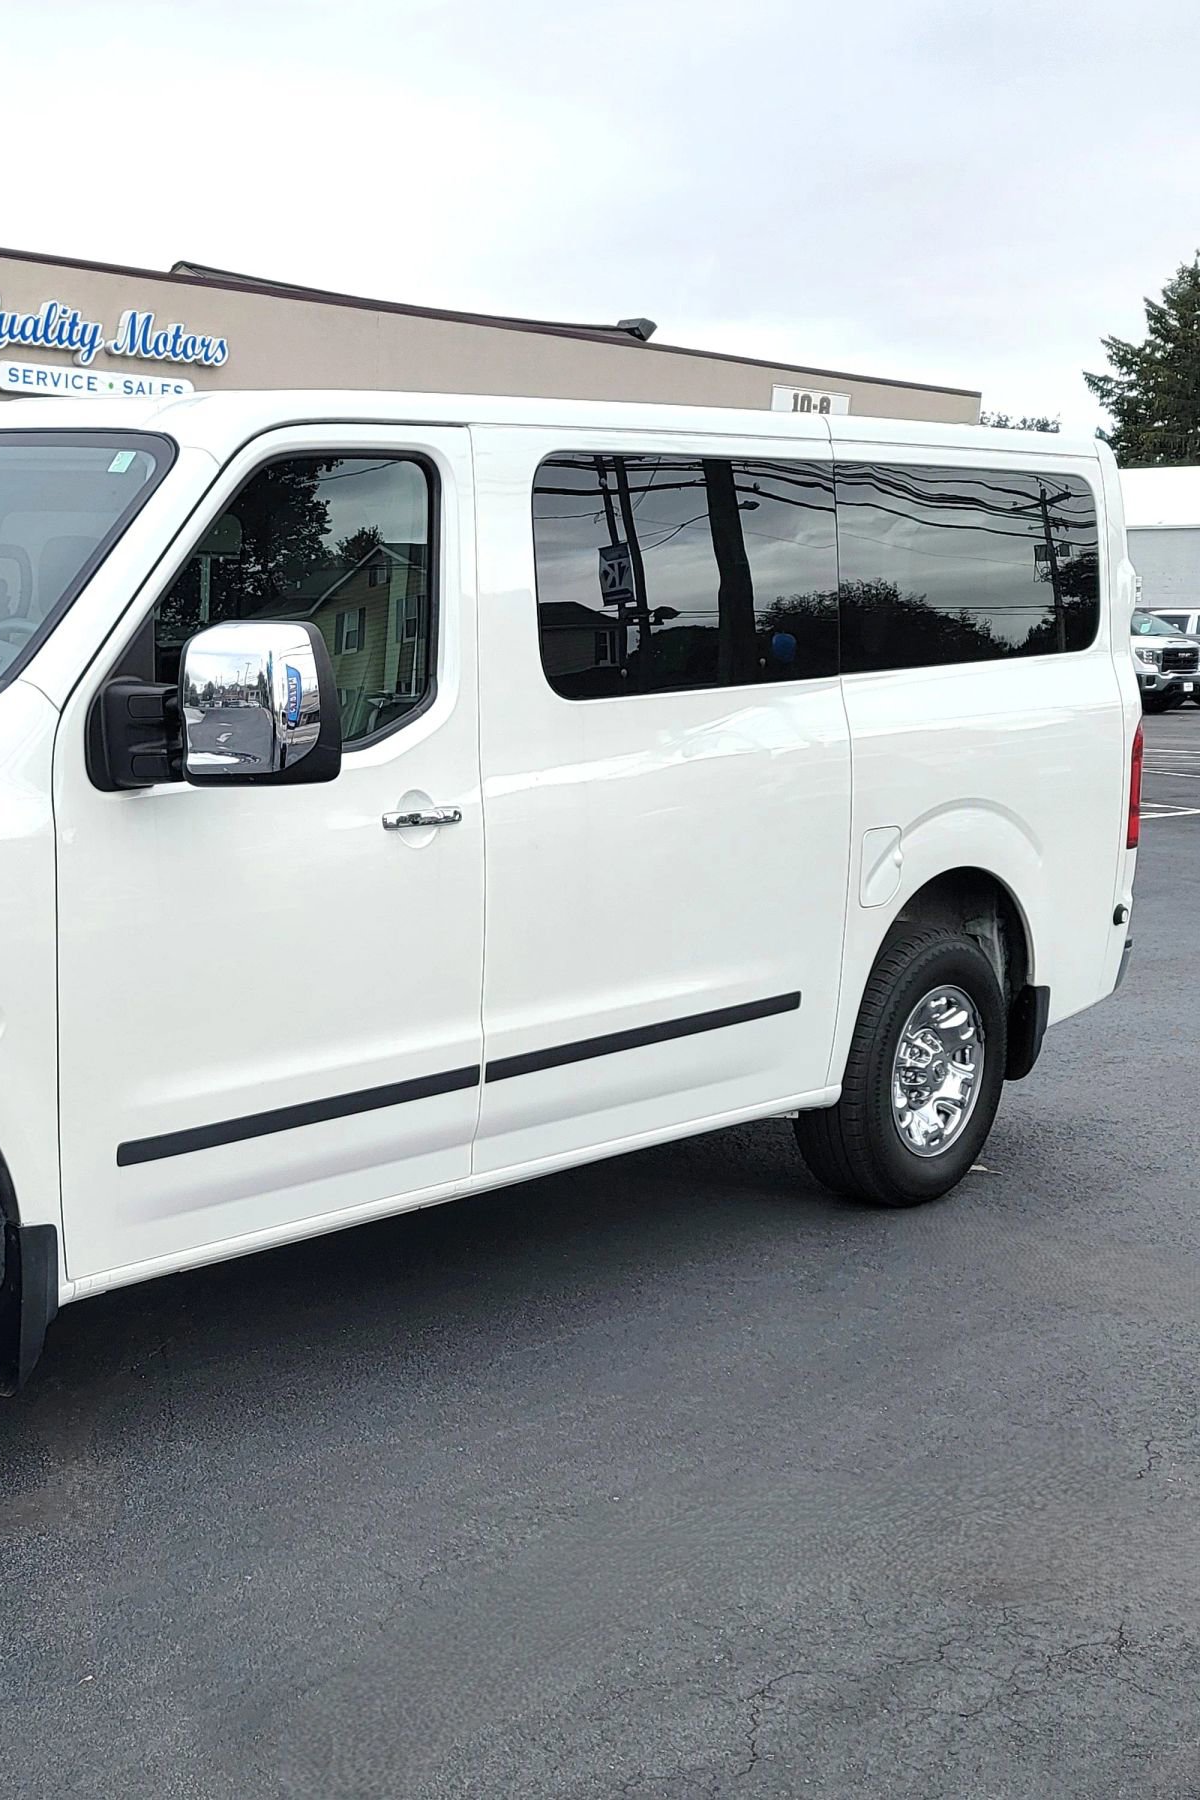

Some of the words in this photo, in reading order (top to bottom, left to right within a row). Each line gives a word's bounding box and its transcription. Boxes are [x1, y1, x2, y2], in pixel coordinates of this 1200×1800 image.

[111, 310, 230, 366] Motors
[7, 367, 99, 392] SERVICE
[792, 392, 831, 414] 10-8
